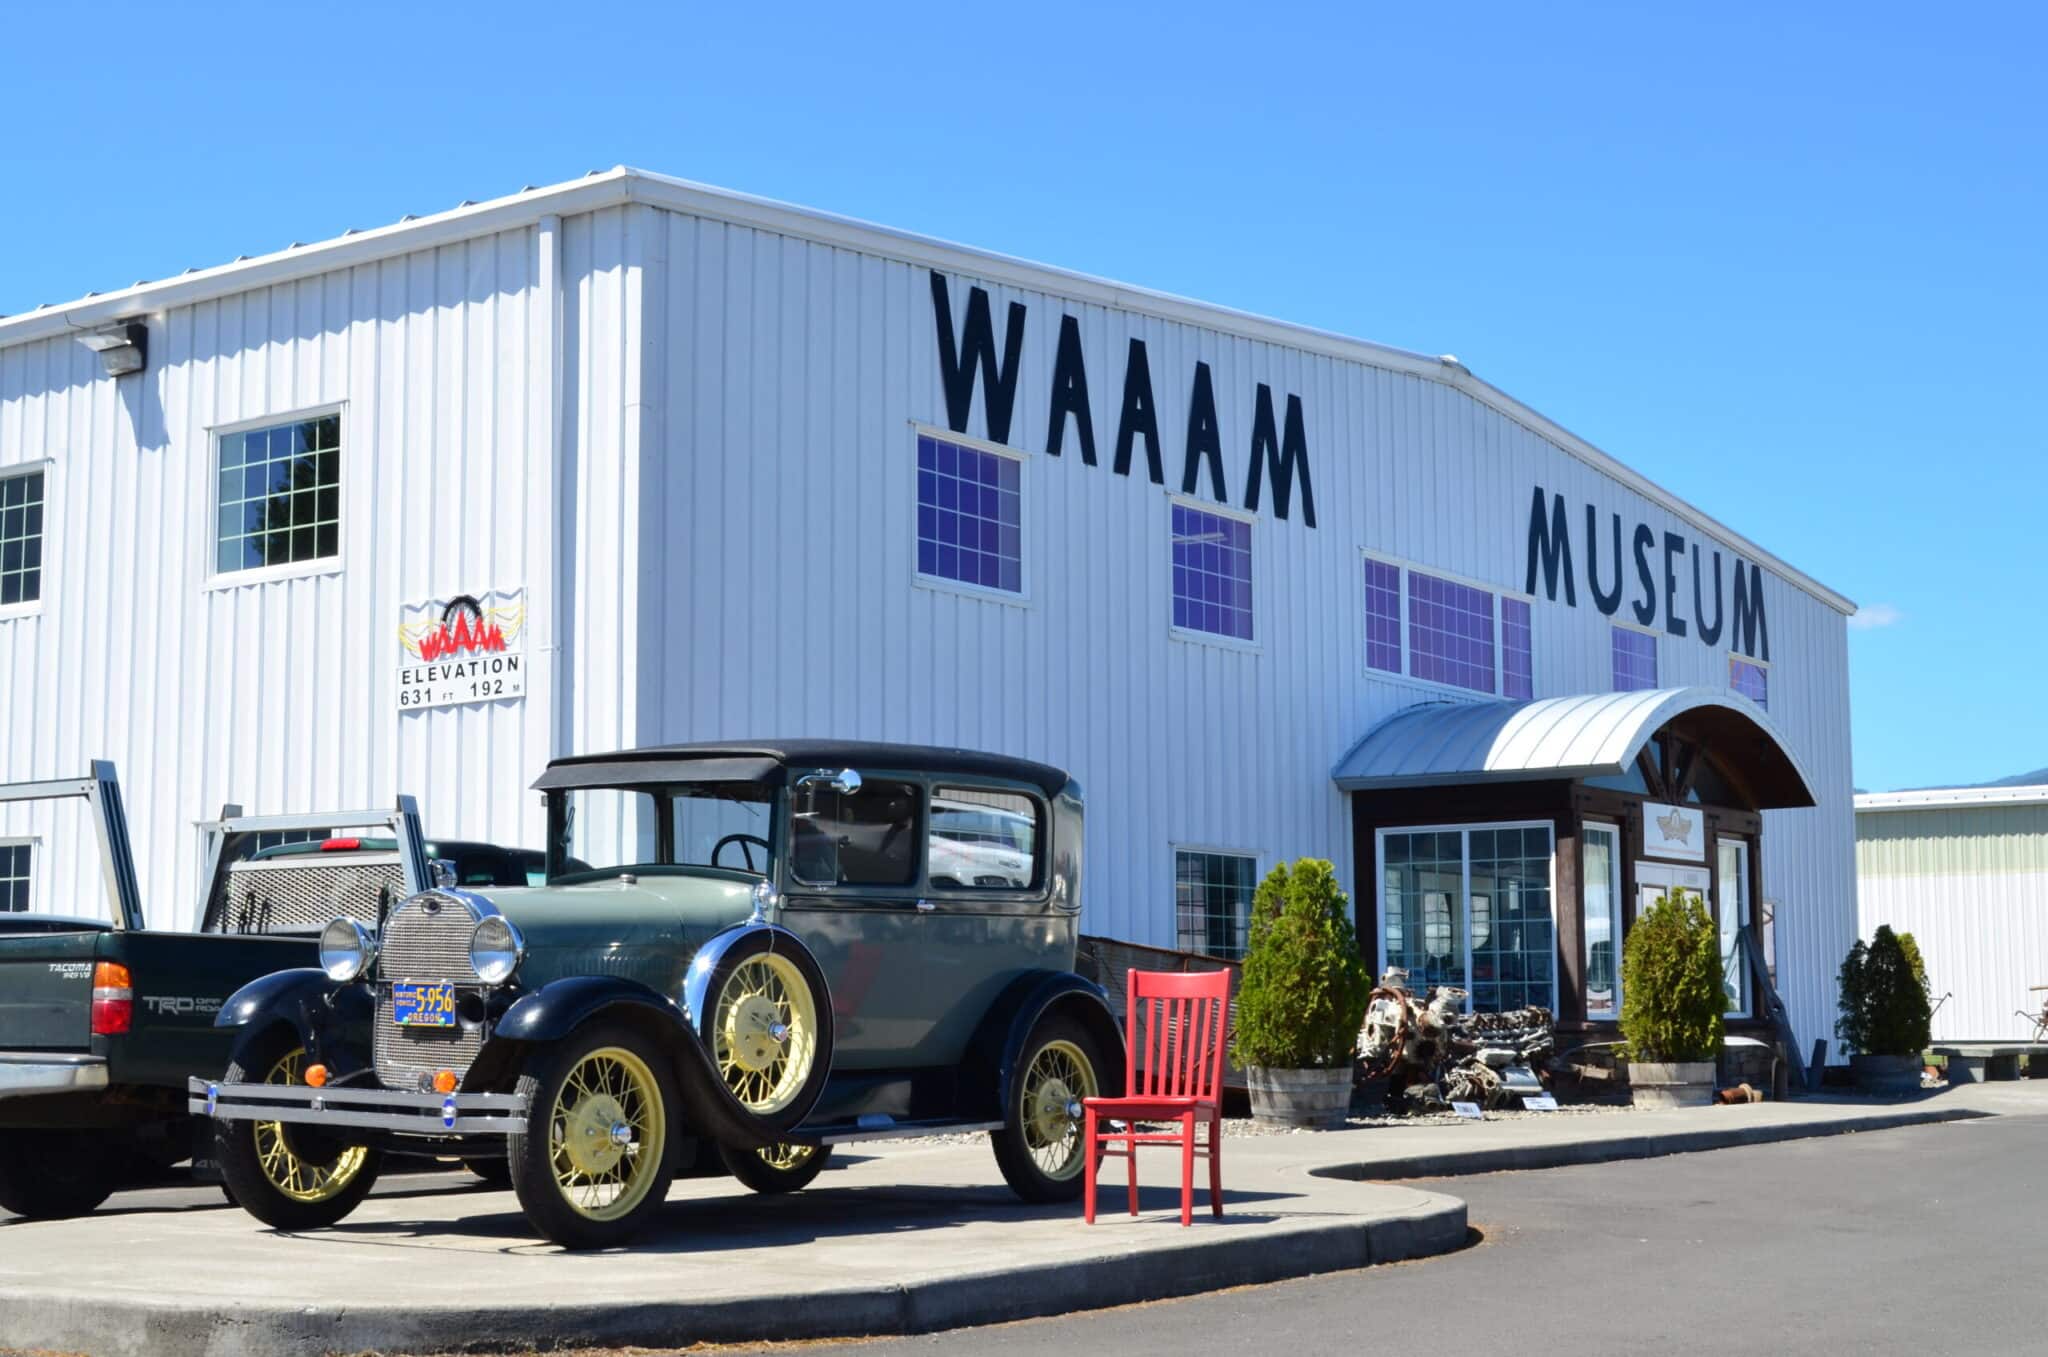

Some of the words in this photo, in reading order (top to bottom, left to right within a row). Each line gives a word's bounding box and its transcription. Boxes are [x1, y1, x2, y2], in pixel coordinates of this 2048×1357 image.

[930, 269, 1316, 528] WAAAM
[1526, 485, 1769, 662] MUSEUM
[402, 656, 518, 685] ELEVATION
[400, 688, 431, 705] 631
[442, 692, 454, 701] FT
[470, 679, 503, 697] 192
[48, 963, 92, 972] TACOMA
[142, 996, 194, 1015] TRD
